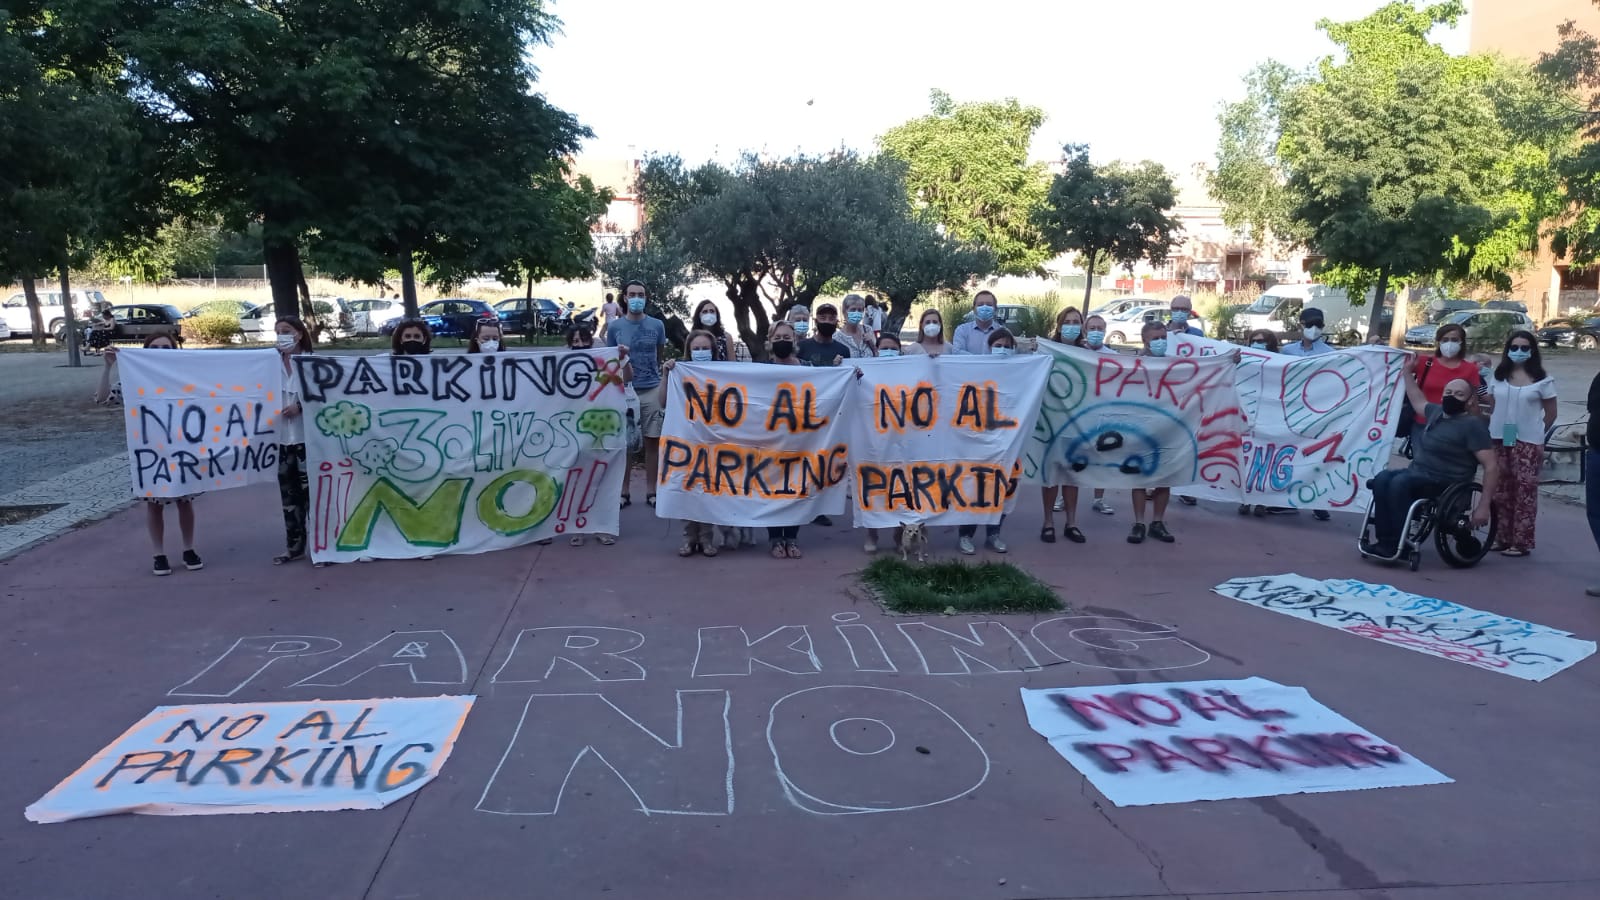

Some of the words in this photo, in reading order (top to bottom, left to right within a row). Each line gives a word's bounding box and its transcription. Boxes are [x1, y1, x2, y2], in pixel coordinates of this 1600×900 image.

[140, 403, 206, 444] NO
[225, 402, 275, 437] AL
[684, 381, 744, 426] NO
[768, 385, 828, 431] AL
[879, 386, 933, 429] NO
[956, 385, 1017, 429] AL
[134, 441, 276, 488] PARKING
[661, 440, 848, 496] PARKING
[164, 713, 266, 743] NO
[279, 707, 388, 741] AL
[1048, 690, 1182, 730] NO
[1166, 686, 1297, 721] AL
[475, 685, 990, 815] NO
